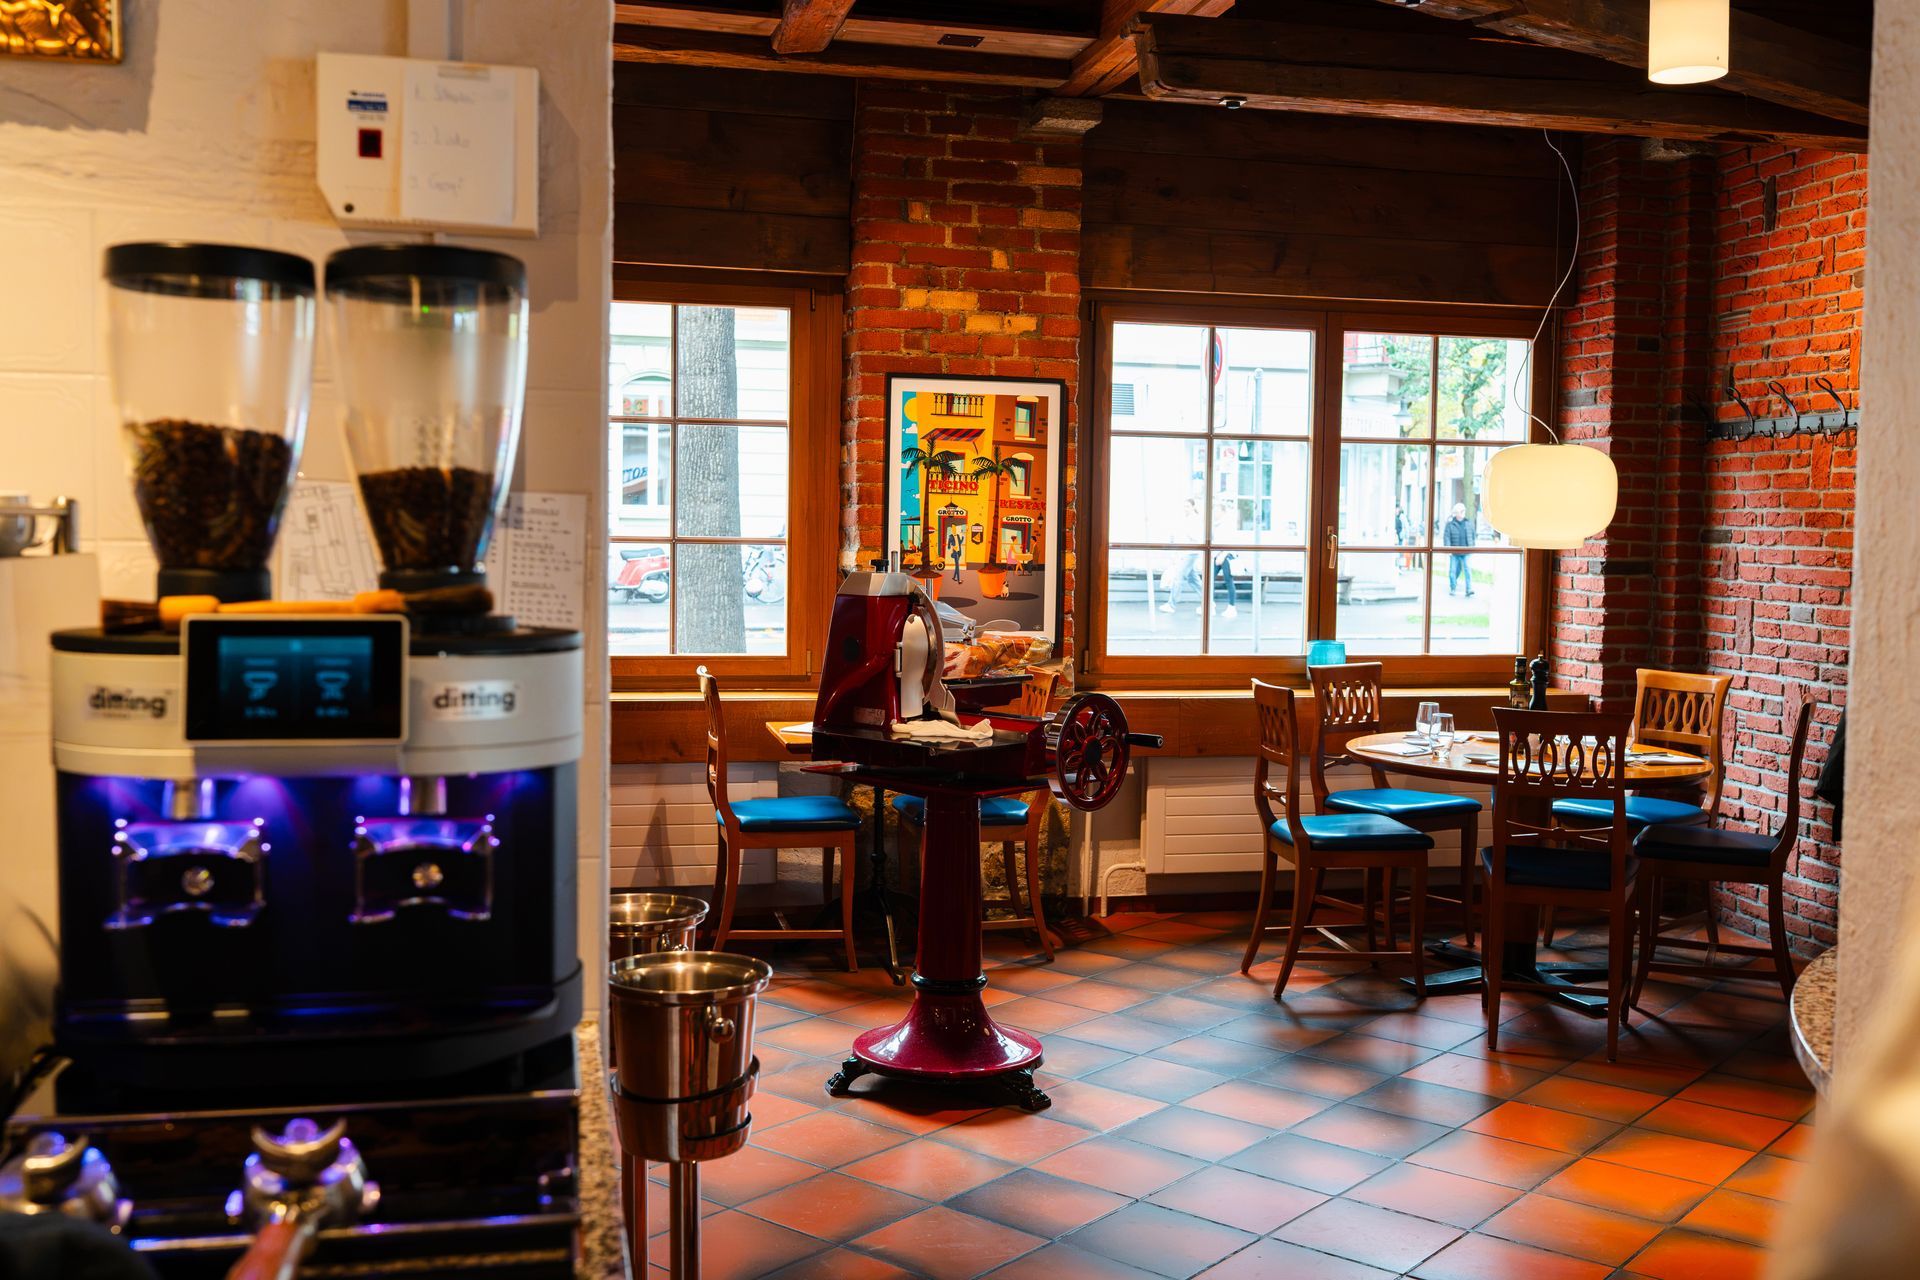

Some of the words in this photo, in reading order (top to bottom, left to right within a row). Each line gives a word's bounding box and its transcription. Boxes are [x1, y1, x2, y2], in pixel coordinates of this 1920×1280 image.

[929, 480, 978, 491] TICINO
[89, 686, 168, 719] ditting
[433, 685, 516, 713] ditting
